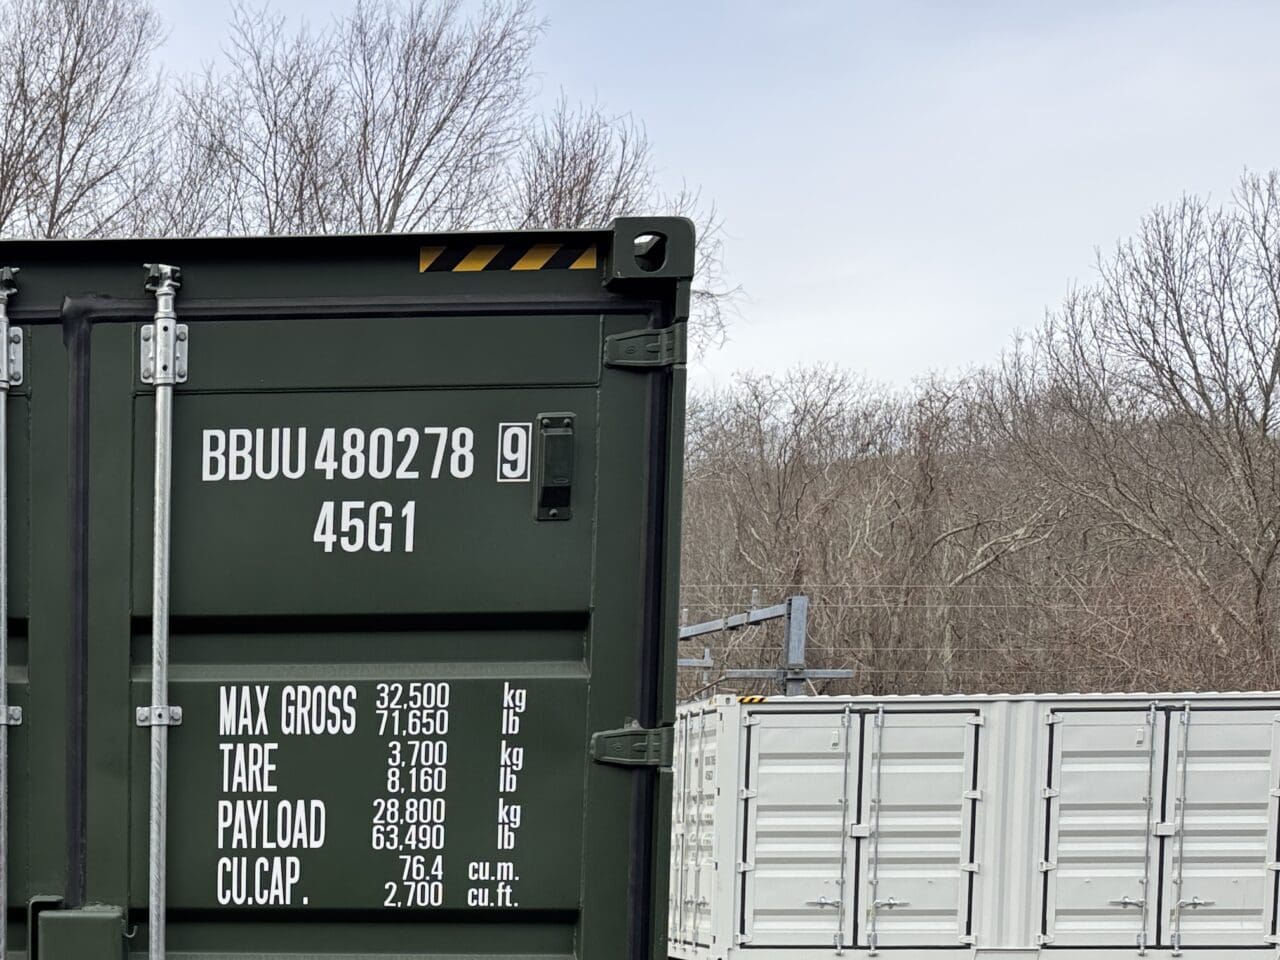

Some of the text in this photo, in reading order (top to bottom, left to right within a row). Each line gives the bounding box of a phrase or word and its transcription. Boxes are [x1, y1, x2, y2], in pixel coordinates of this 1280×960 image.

[500, 425, 528, 480] 9
[313, 500, 415, 552] 45G1
[219, 685, 357, 735] MAX GROSS
[376, 682, 526, 712] 32,500 kg
[375, 709, 520, 736] 71,650 lb
[219, 742, 278, 792] TARE
[387, 740, 523, 770] 3,700 kg
[387, 767, 517, 794] 8,160 lb
[217, 800, 326, 849] PAYLOAD
[372, 798, 521, 828] 28,800 kg
[371, 824, 515, 851] 63,490 lb
[398, 855, 520, 881] 76.4 cu.m.
[383, 882, 518, 908] 2,700 cu.ft.
